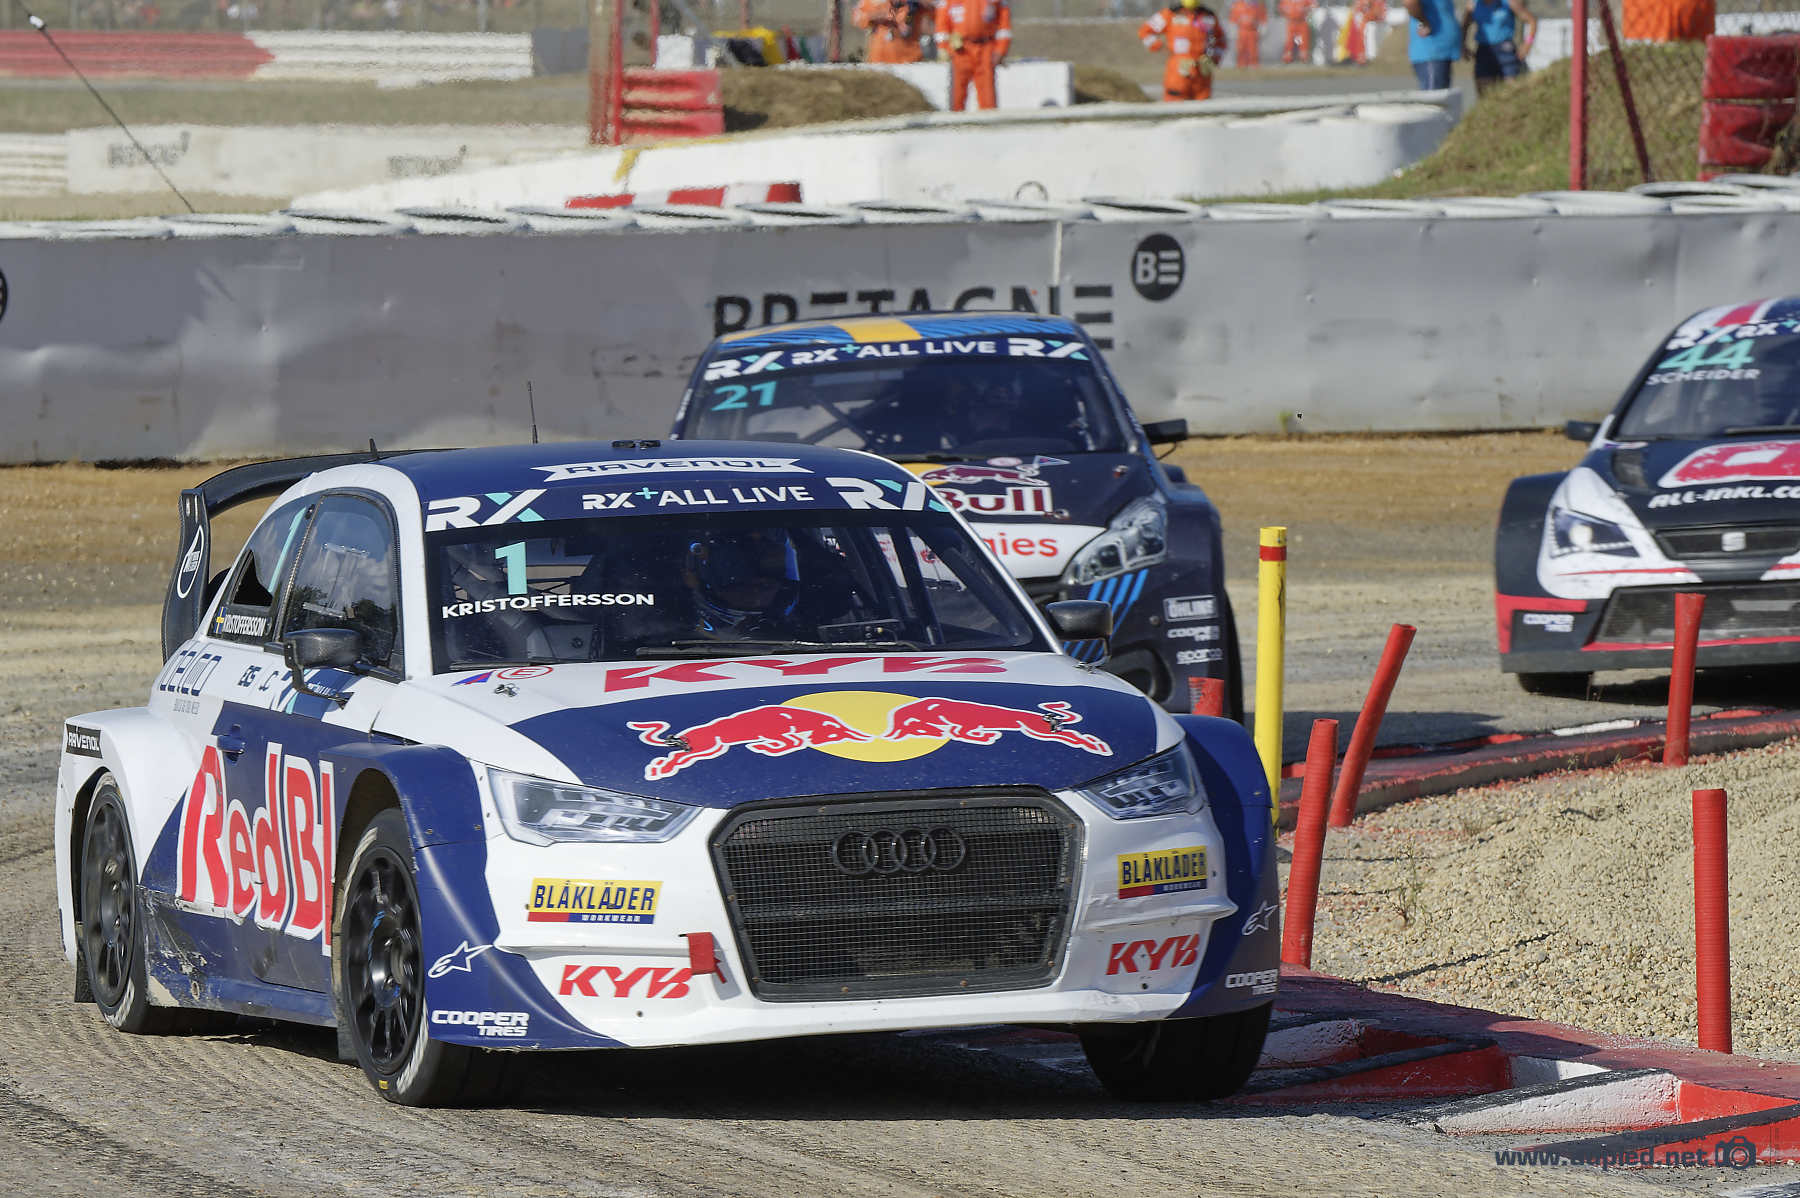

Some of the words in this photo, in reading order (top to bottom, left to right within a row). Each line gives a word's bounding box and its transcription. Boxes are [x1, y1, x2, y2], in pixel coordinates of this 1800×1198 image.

[714, 284, 1114, 351] BRTNE
[704, 349, 784, 381] RX
[925, 339, 997, 355] LIVE
[1008, 337, 1089, 361] RX
[1657, 339, 1755, 372] 44
[1646, 368, 1761, 386] SCHEIDER
[711, 381, 777, 411] 21
[566, 459, 782, 474] RAVENOL
[426, 490, 547, 532] RX
[736, 486, 814, 503] LIVE
[825, 477, 950, 512] RX
[494, 541, 528, 595] 1
[442, 593, 655, 619] KRISTOFFERSSON
[604, 656, 1008, 693] KYB
[68, 732, 100, 752] RAVENOL
[533, 880, 657, 912] BLÅKLÄDER
[1106, 934, 1200, 976] KYB
[559, 964, 692, 999] KYB
[1225, 968, 1278, 988] COOPER
[431, 1010, 529, 1027] COOPER
[477, 1025, 528, 1037] TIRES
